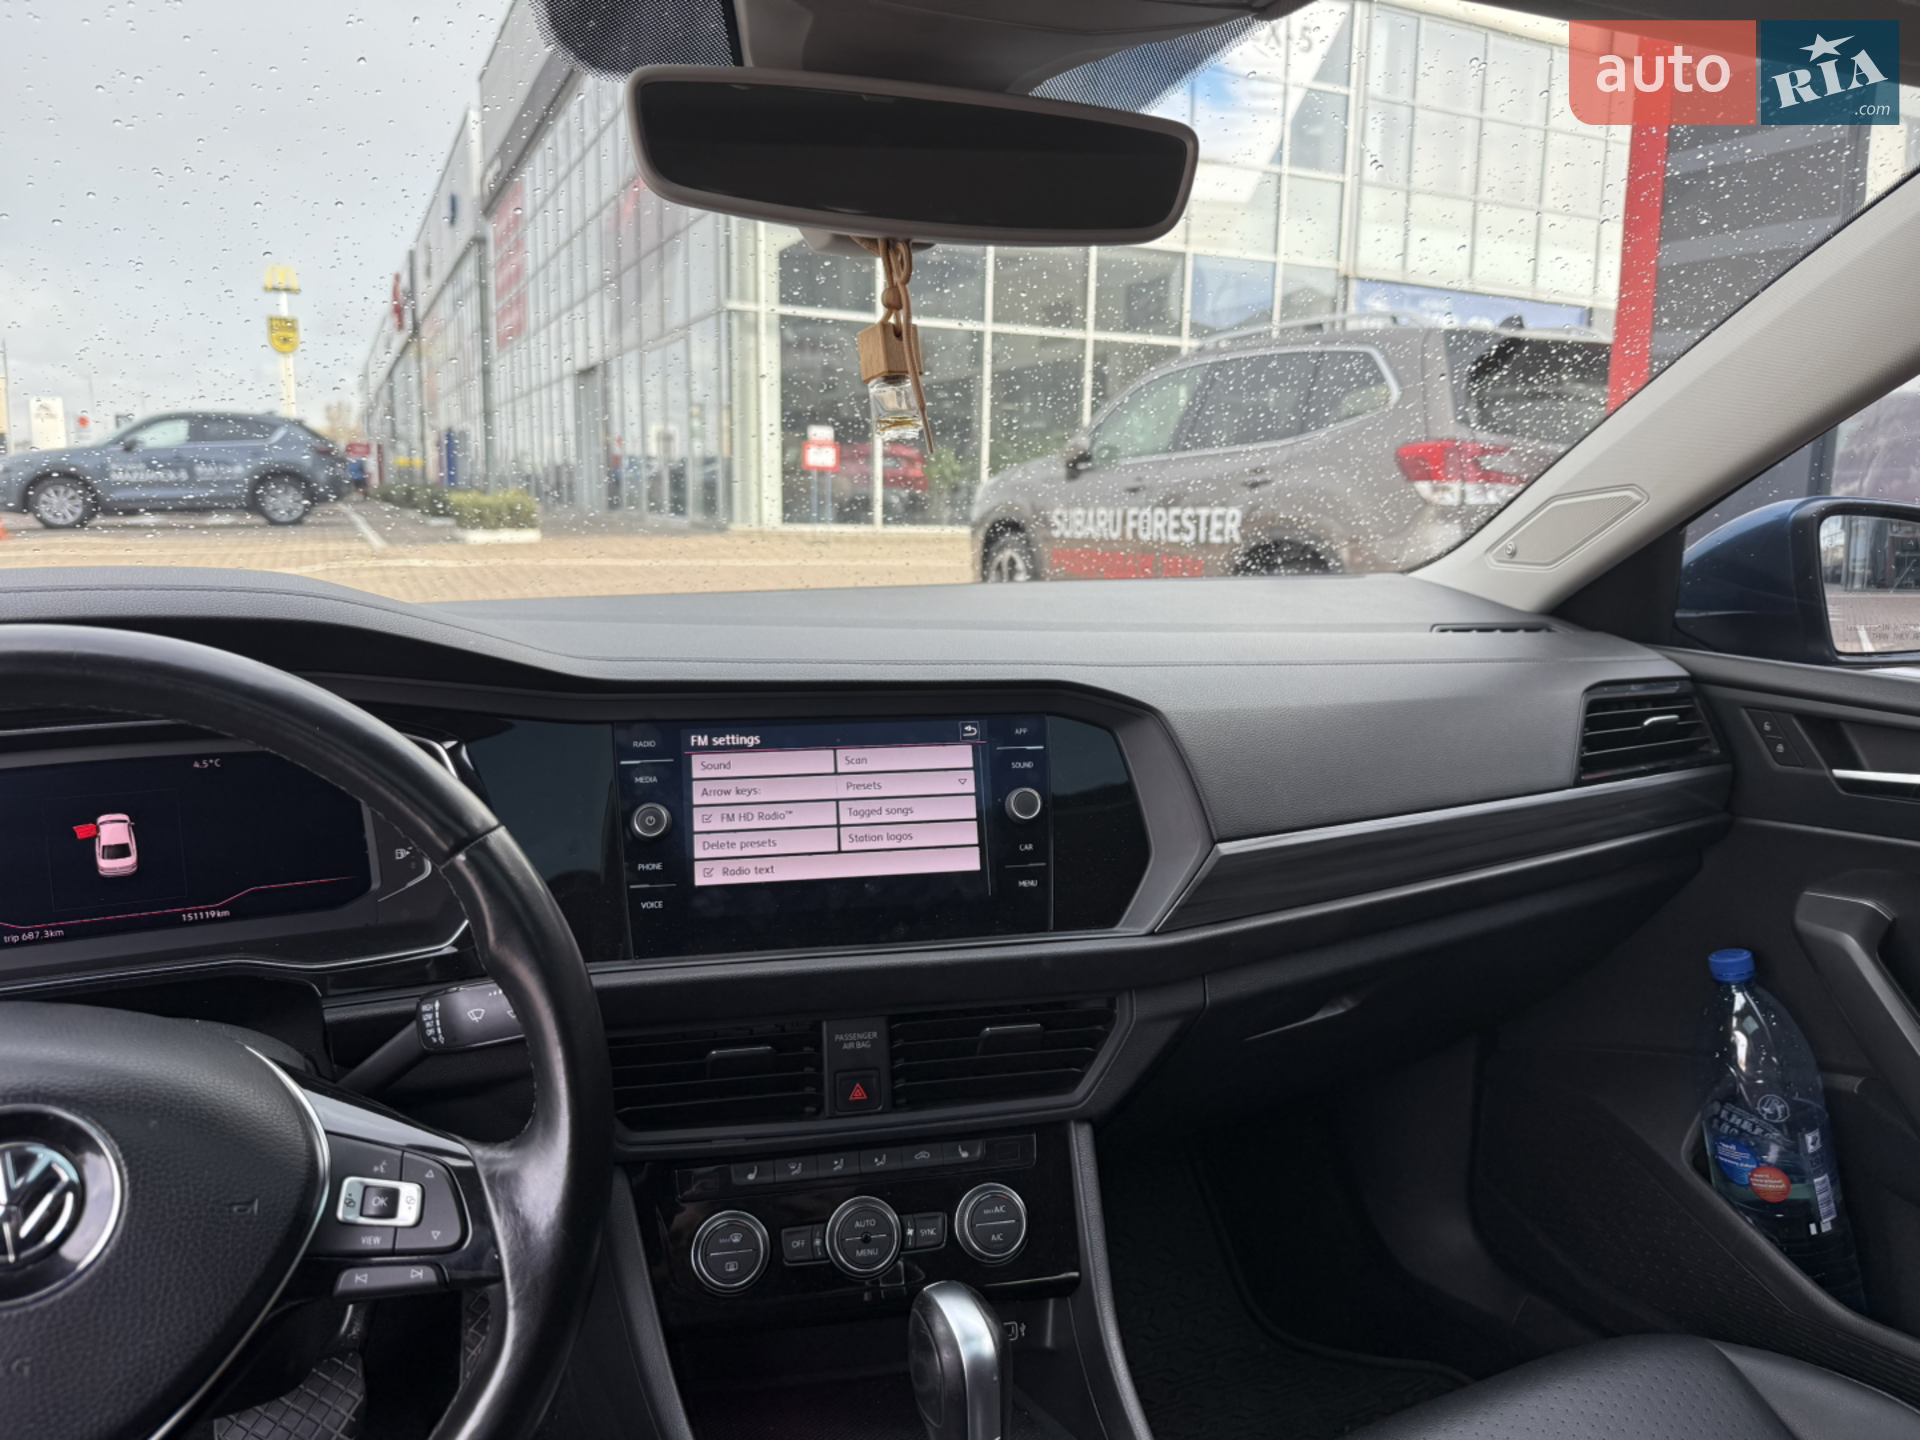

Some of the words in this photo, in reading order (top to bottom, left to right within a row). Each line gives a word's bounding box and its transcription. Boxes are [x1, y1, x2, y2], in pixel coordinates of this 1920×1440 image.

[1051, 506, 1123, 539] SUBARU
[1125, 506, 1243, 544] FORESTER
[1015, 727, 1029, 735] APP
[633, 740, 656, 748] RADIO
[690, 734, 709, 747] FM
[711, 733, 761, 747] settings
[700, 760, 732, 771] Sound
[844, 755, 868, 766] Scan
[1011, 760, 1034, 769] SOUND
[635, 775, 658, 784] MEDIA
[846, 780, 882, 791] Presets
[701, 786, 731, 797] Arrow
[735, 785, 762, 798] keys:
[720, 813, 735, 823] FM
[738, 812, 754, 822] HD
[848, 806, 882, 818] Tagged
[884, 806, 914, 817] songs
[848, 832, 883, 843] Station
[886, 830, 914, 844] logos
[702, 839, 736, 850] Delete
[740, 837, 777, 850] presets
[1019, 843, 1034, 851] CAR
[638, 862, 663, 871] PHONE
[722, 865, 752, 876] Radio
[755, 864, 775, 875] text
[1018, 879, 1038, 888] MENU
[641, 901, 663, 909] VOICE
[3, 932, 20, 944] trip
[834, 1031, 878, 1041] PASSENGER
[371, 1195, 389, 1208] OK
[854, 1218, 877, 1228] AUTO
[919, 1227, 937, 1237] SYNC
[361, 1235, 382, 1246] VIEW
[791, 1239, 806, 1248] OFF
[855, 1248, 879, 1258] MENU
